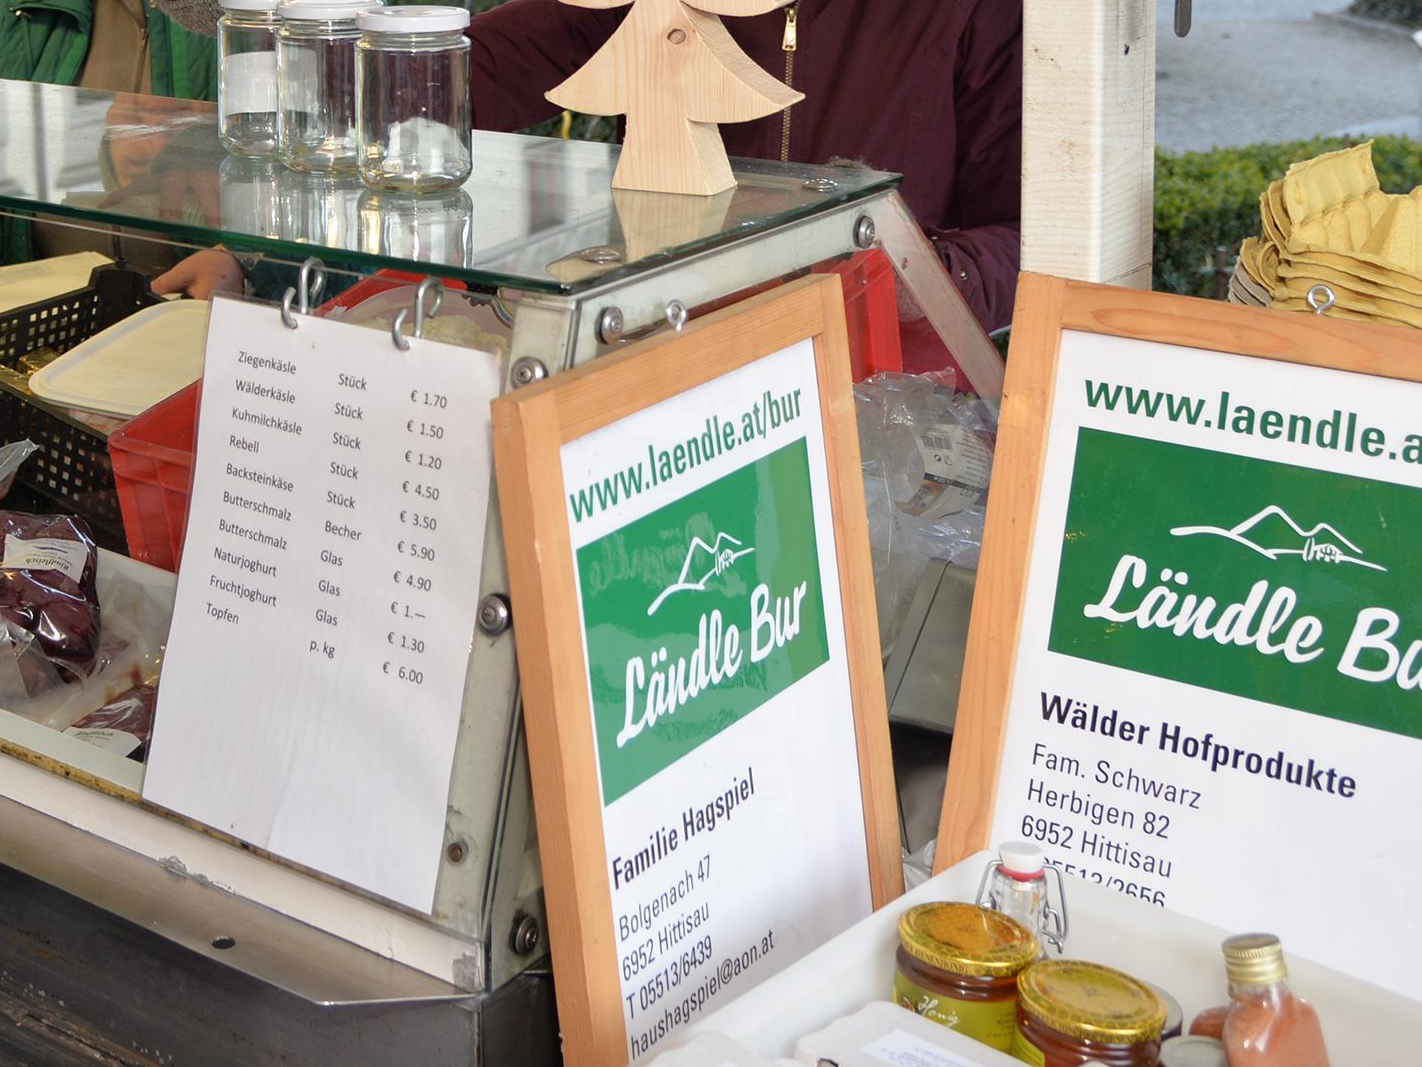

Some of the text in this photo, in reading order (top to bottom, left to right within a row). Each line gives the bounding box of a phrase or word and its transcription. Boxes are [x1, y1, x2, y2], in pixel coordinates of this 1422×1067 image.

[235, 379, 444, 440] Wälderkäsle Stück € 1.50
[237, 350, 448, 409] Ziegenkäsle Stück € 1.70
[229, 435, 440, 501] Rebell Stück € 4.50
[232, 406, 442, 470] Kuhmilchkäsle Stück € 1.20
[569, 387, 802, 524] www.laendle.at/bur
[222, 491, 436, 562] Butterschmalz Becher € 5.90
[225, 463, 437, 531] Backsteinkäse Stück € 3.50
[213, 547, 277, 578] Naturjoghurt
[318, 579, 341, 597] Glas
[390, 601, 398, 614] €
[218, 519, 432, 592] Butterschmalz Glas € 4.90
[206, 602, 424, 685] Topfen p. kg € 6.00
[209, 575, 425, 654] Fruchtjoghurt Glas € 1.30
[1083, 553, 1326, 665] Ländle
[616, 581, 807, 749] Ländle Bur
[1032, 742, 1201, 809] Fam. Schwarz
[1040, 691, 1357, 799] Wälder Hofprodukte
[612, 766, 755, 890] Familie Hagspiel
[1027, 778, 1171, 839] Herbigen 82
[1021, 815, 1172, 879] 6952 Hittisau
[618, 854, 711, 942] Bolgenach 47
[622, 902, 710, 982] 6952 Hittisau
[626, 935, 713, 1020] T 05513/6439
[631, 929, 775, 1061] haushagspiel@aon.at
